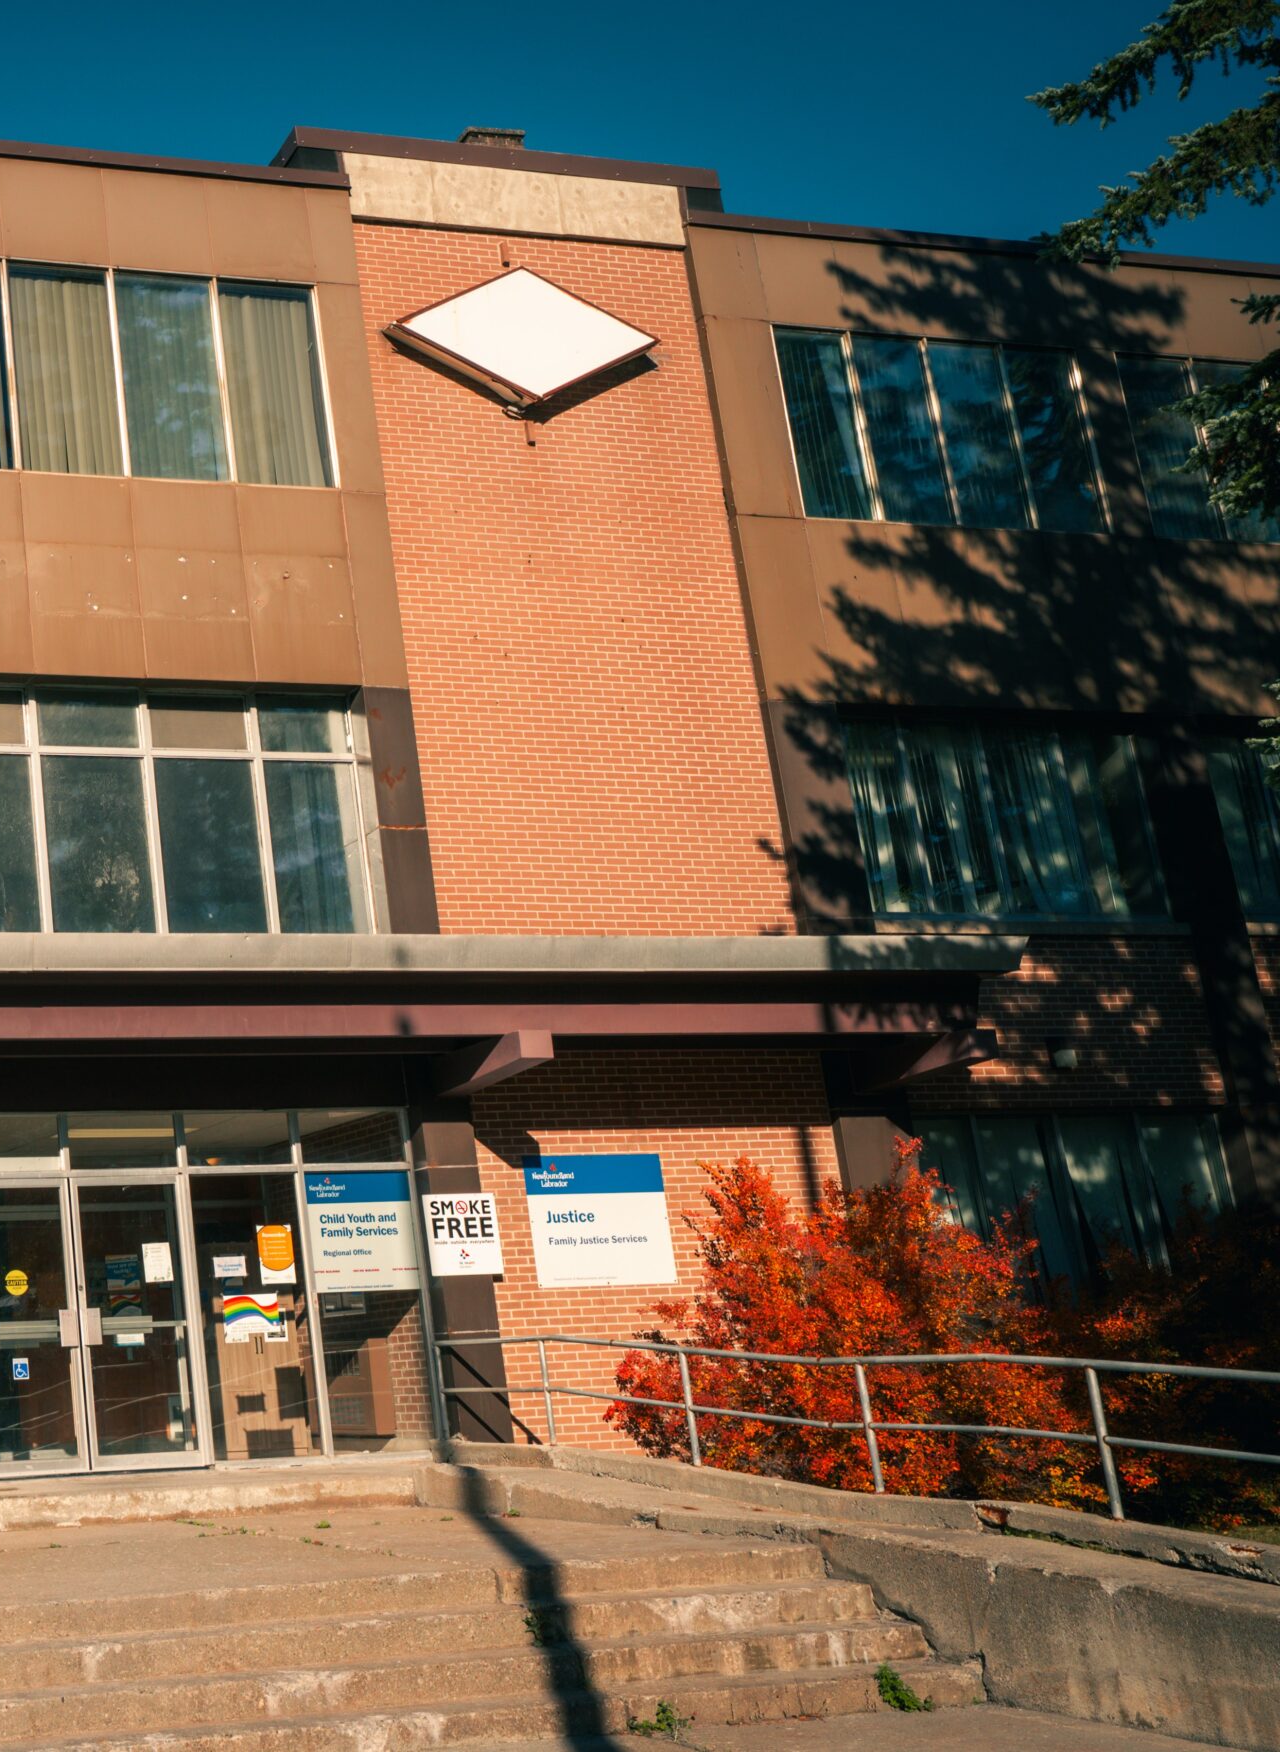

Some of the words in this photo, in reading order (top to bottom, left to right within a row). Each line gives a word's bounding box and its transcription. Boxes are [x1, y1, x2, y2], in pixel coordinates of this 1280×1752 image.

[531, 1170, 575, 1181] Newfoundland
[308, 1183, 346, 1192] Newfoundland
[540, 1180, 569, 1188] Labrador
[430, 1199, 491, 1216] SMOKE
[319, 1214, 346, 1224] Child
[347, 1213, 376, 1223] Youth
[378, 1212, 397, 1222] and
[546, 1209, 595, 1224] Justice
[321, 1227, 354, 1239] Family
[355, 1225, 399, 1237] Services
[431, 1216, 494, 1239] FREE
[548, 1236, 578, 1247] Family
[579, 1236, 610, 1245] Justice
[611, 1234, 648, 1244] Services
[323, 1248, 352, 1258] Regional
[352, 1248, 372, 1256] Office
